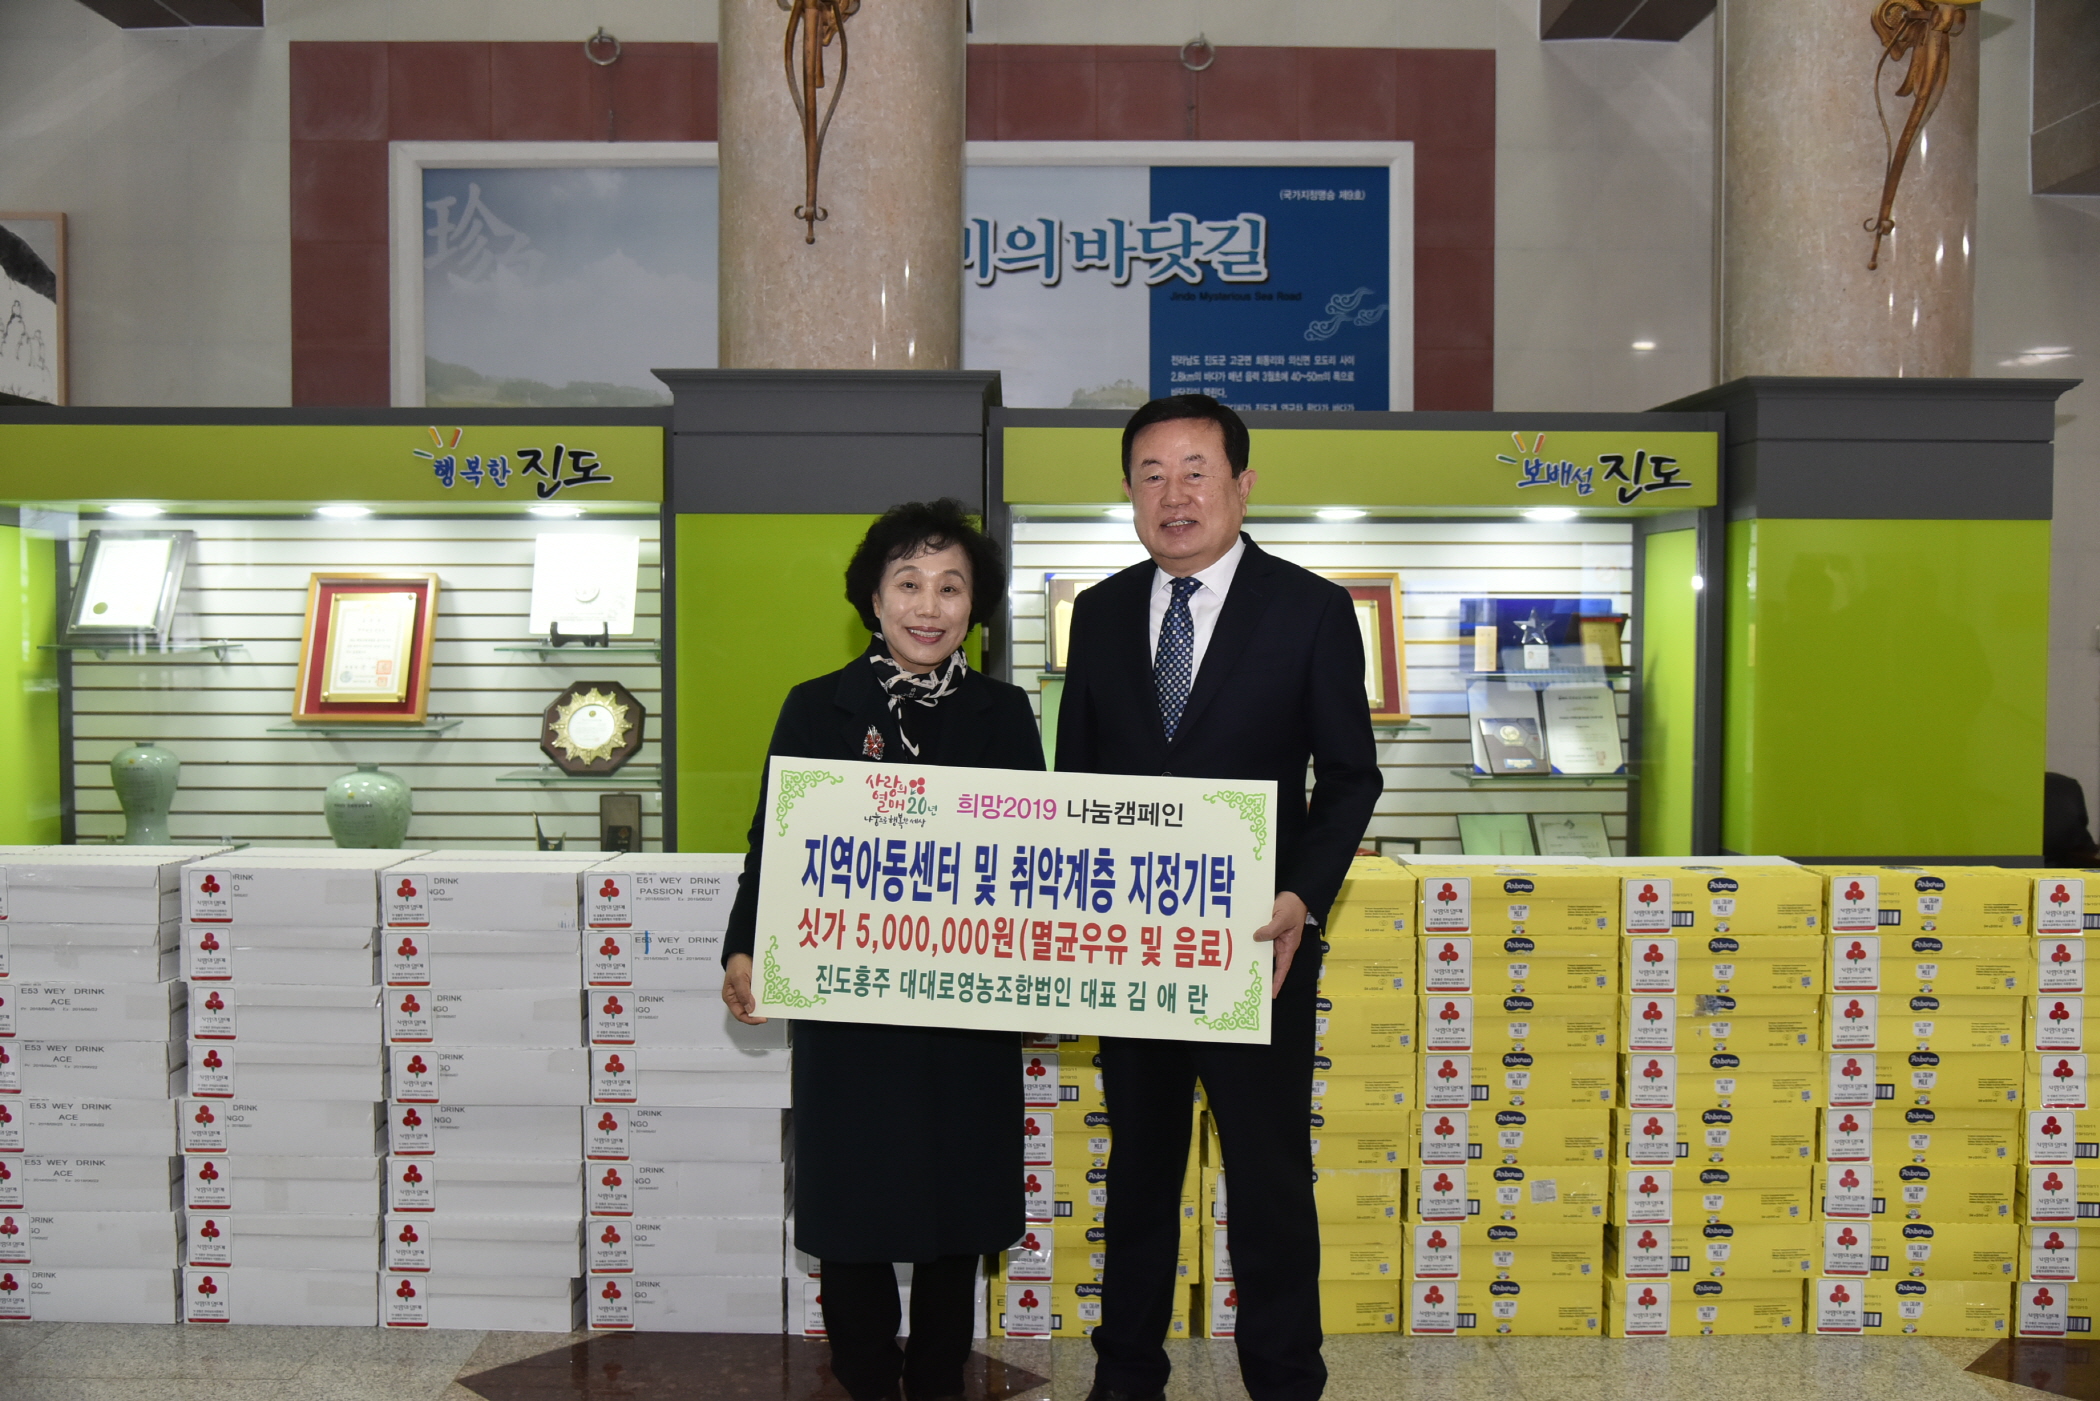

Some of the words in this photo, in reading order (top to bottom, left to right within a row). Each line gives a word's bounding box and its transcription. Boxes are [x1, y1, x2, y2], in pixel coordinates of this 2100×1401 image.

[1067, 214, 1267, 284] 바닷길
[1171, 292, 1196, 301] Jindo
[1200, 292, 1251, 302] Mysterious
[1255, 292, 1273, 301] Sea
[1277, 292, 1302, 301] Road
[433, 455, 513, 488] 행복한
[516, 444, 614, 499] 진도
[1516, 458, 1595, 496] 보배섬
[1599, 449, 1693, 504] 진도
[865, 773, 907, 797] 사랑의
[906, 796, 938, 817] 20년
[956, 793, 1058, 820] 희망2019
[1066, 799, 1184, 827] 나눔캠페인
[801, 834, 961, 906] 지역아동센터
[974, 843, 998, 907] 및
[1010, 846, 1117, 914] 취약계층
[1127, 851, 1236, 918] 지정기탁
[797, 907, 846, 950] 싯가
[1140, 925, 1162, 967] 및
[1173, 926, 1234, 971] 음료)
[815, 963, 891, 999] 진도홍주
[899, 967, 1071, 1008] 대대로영농조합법인
[1080, 978, 1117, 1010] 대표
[1126, 981, 1146, 1012] 김
[1156, 982, 1177, 1014] 애
[1187, 982, 1209, 1015] 란
